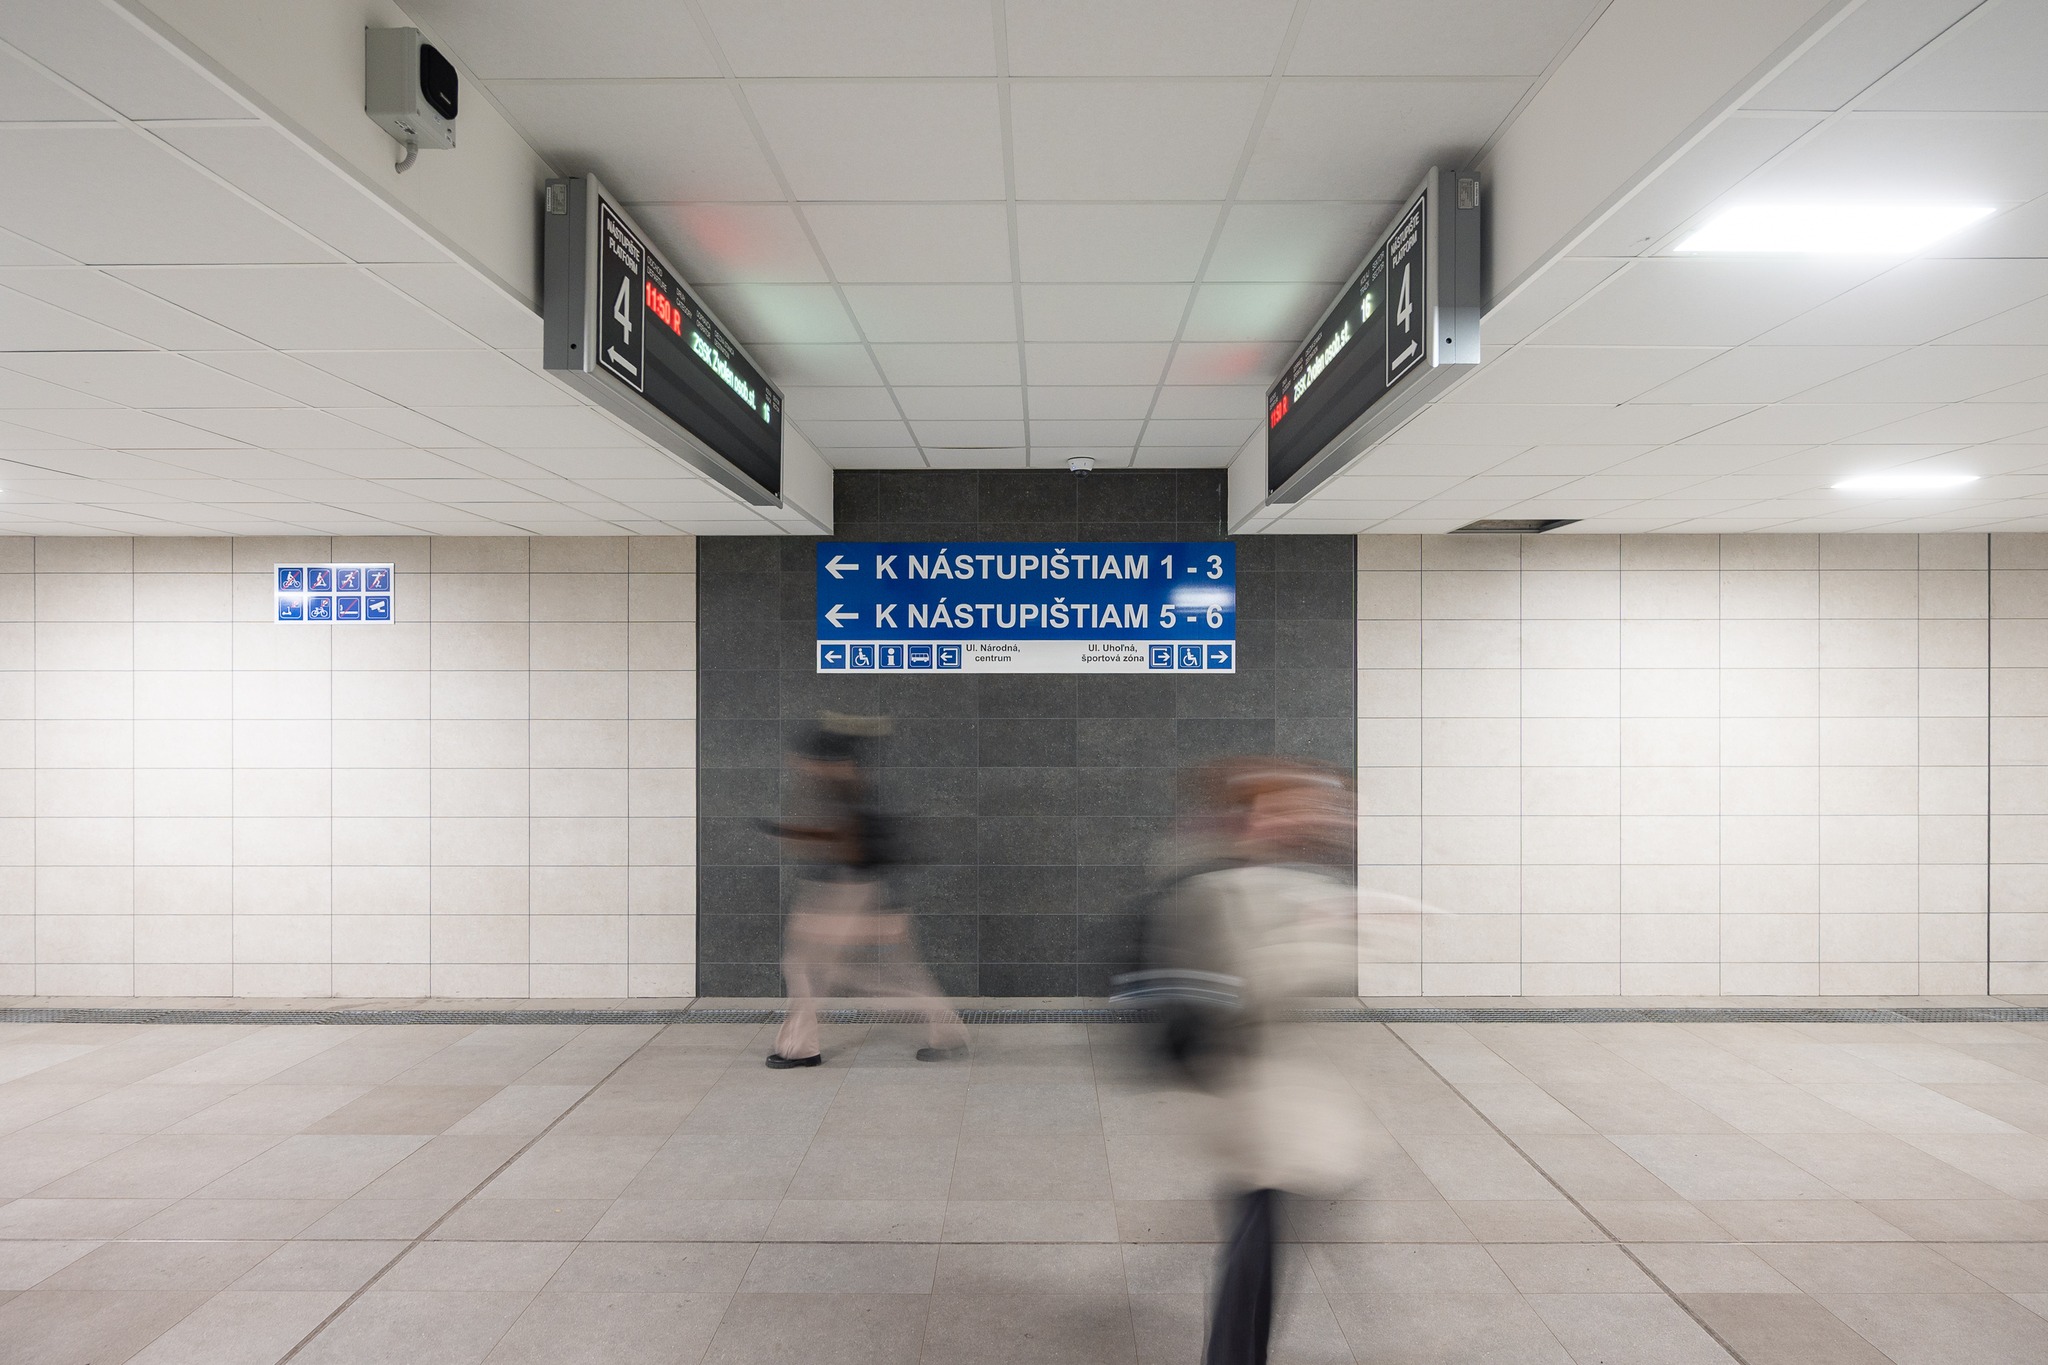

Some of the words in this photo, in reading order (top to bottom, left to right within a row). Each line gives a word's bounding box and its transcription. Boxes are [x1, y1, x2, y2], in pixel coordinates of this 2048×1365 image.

[607, 218, 640, 262] NÁSTUPIŠTE
[1391, 211, 1420, 257] NÁSTUPIŠTE
[1392, 230, 1418, 270] PLATFORM
[609, 236, 638, 275] PLATFORM
[613, 275, 632, 345] 4
[1361, 292, 1373, 323] 16
[1396, 262, 1413, 333] 4
[646, 281, 671, 325] 11:50
[673, 308, 682, 336] R
[712, 349, 734, 388] Zvolen
[876, 555, 898, 579] K
[908, 548, 1149, 580] NÁSTUPIŠTIAM
[1160, 555, 1173, 579] 1
[1206, 555, 1224, 580] 3
[875, 604, 898, 628] K
[908, 597, 1149, 629] NÁSTUPIŠTIAM
[1159, 604, 1176, 629] 5
[1206, 604, 1224, 629] 6
[965, 644, 978, 652] Ul.
[980, 642, 1021, 654] Národná,
[974, 654, 1012, 662] centrum
[1081, 653, 1121, 665] športová
[1123, 653, 1145, 663] zóna
[1088, 644, 1101, 652] Ul.
[1102, 643, 1138, 654] Uhoľná,
